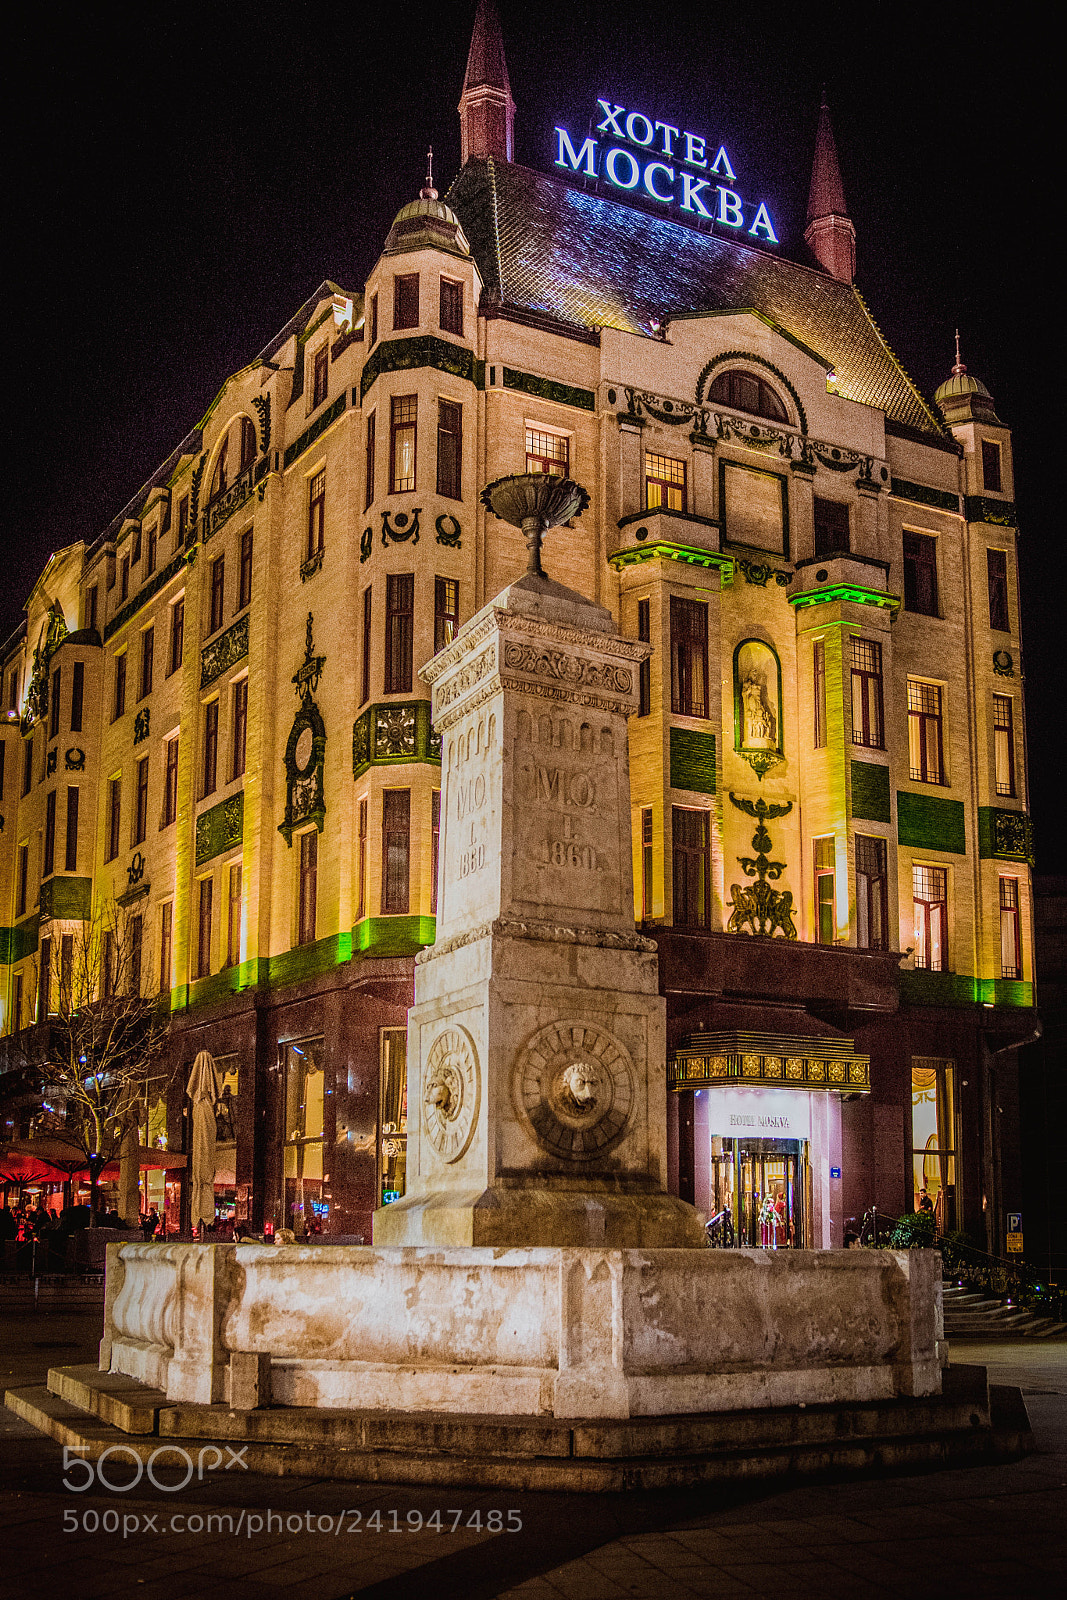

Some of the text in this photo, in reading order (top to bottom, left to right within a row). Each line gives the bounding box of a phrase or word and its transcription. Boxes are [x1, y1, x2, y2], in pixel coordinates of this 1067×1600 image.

[596, 97, 737, 180] ХОТЕЛ
[554, 125, 780, 244] МОСКВА
[1010, 1215, 1019, 1231] P
